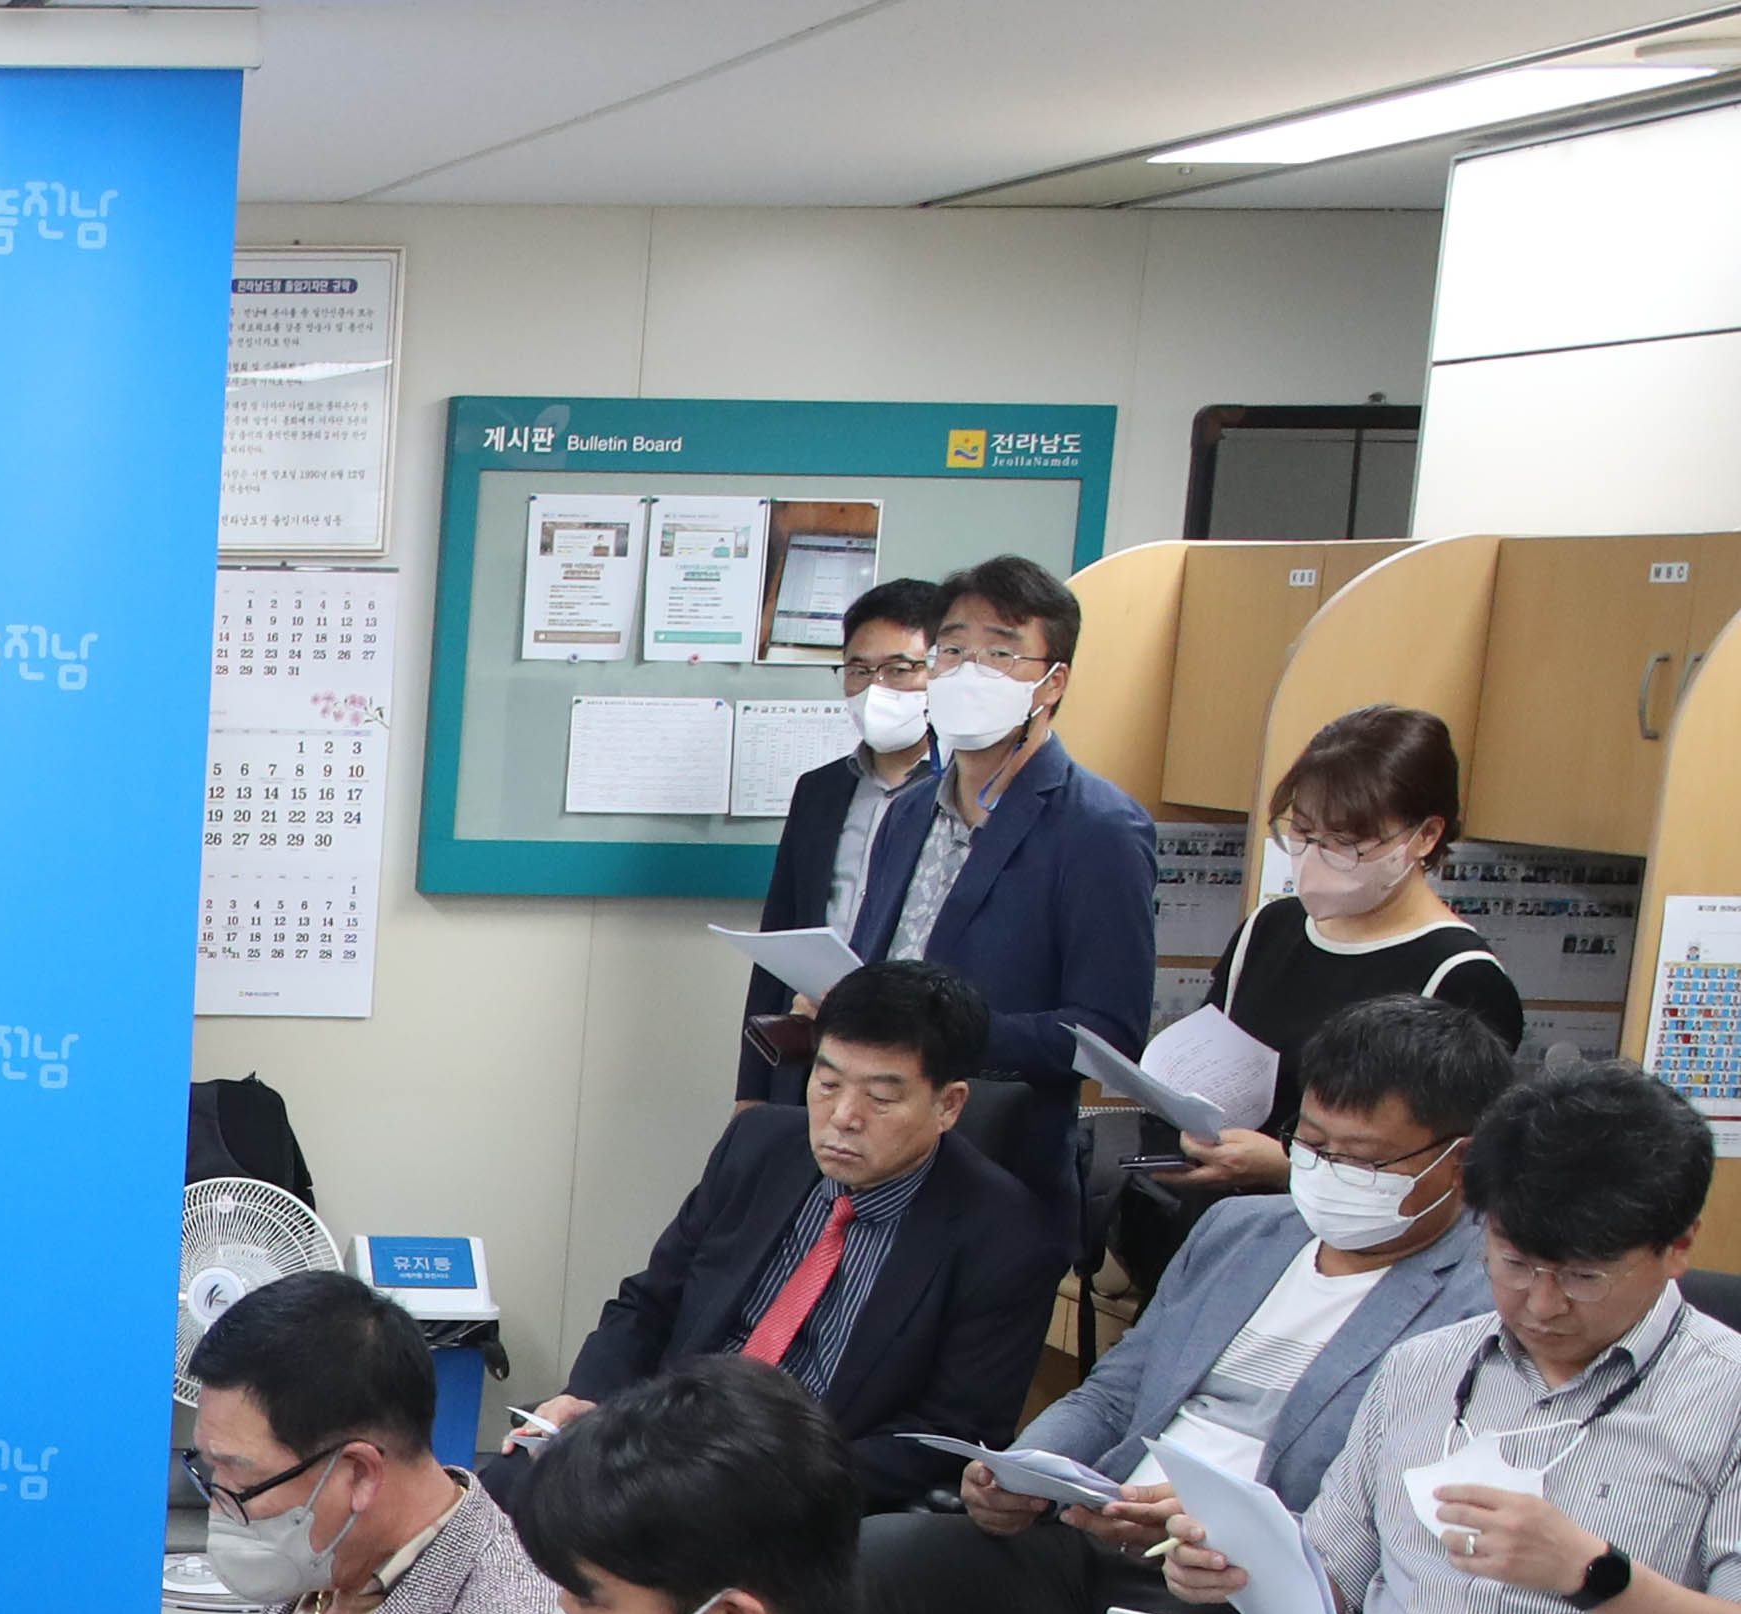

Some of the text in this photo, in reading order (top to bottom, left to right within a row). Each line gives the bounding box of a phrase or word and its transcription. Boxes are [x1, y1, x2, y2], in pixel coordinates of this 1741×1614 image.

[483, 425, 684, 453] 게시판 Bulletin Board
[990, 433, 1082, 454] 전라남도
[992, 456, 1080, 468] JeollaNamdo
[247, 598, 376, 611] 1 2 3 4 5 6
[221, 614, 378, 628] 7 8 9 10 11 12 13
[218, 631, 377, 644] 14 15 16 17 18 19 20
[216, 647, 376, 661] 21 22 23 24 25 26 27
[214, 664, 300, 677] 28 29 30 31
[298, 740, 362, 755] 1 2 3
[212, 762, 365, 778] 5 6 7 8 9 10
[208, 785, 364, 801] 12 13 14 15 16 17
[207, 808, 362, 825] 19 20 21 22 23 24
[204, 832, 333, 848] 26 27 28 29 30
[351, 884, 357, 895] 1
[205, 898, 357, 911] 2 3 4 5 6 7 8
[205, 915, 359, 928] 9 10 11 12 13 14 15
[202, 931, 358, 944] 16 17 18 19 20 21 22
[247, 948, 261, 959] 25
[270, 948, 285, 959] 26
[294, 948, 309, 959] 27
[318, 949, 333, 960] 28
[342, 949, 357, 960] 29
